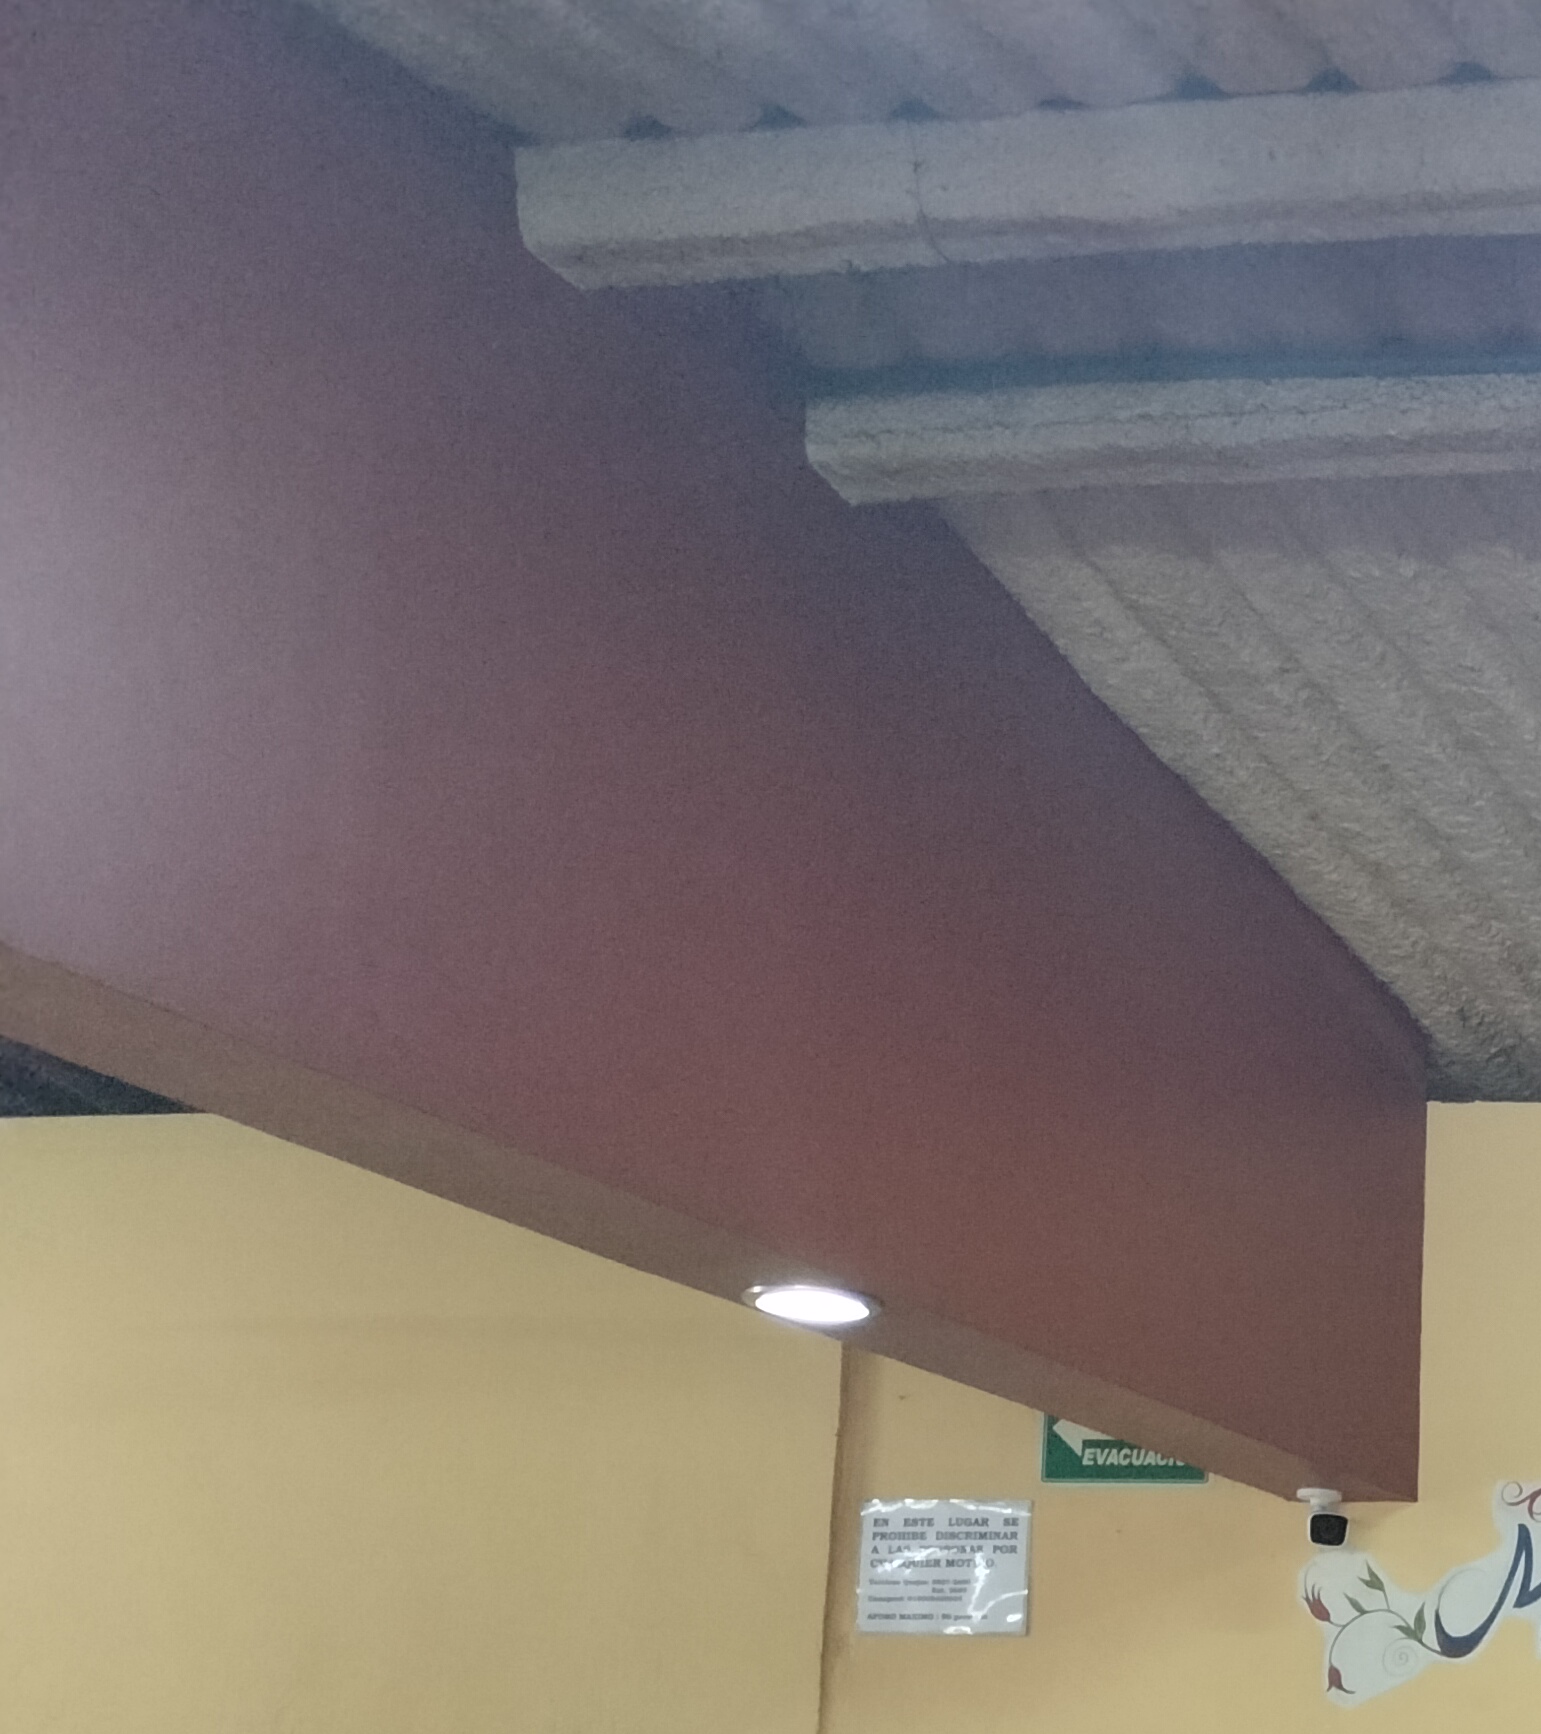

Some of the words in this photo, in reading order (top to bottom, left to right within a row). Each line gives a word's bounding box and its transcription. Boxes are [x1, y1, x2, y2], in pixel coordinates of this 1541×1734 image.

[872, 1517, 890, 1527] EN
[903, 1517, 935, 1527] ESTE
[948, 1517, 990, 1527] LUGAR
[1002, 1517, 1020, 1527] SE
[871, 1531, 928, 1541] PROHIBE
[935, 1531, 1019, 1541] DISCRIMINAR
[870, 1545, 880, 1554] A
[992, 1544, 1018, 1554] POR
